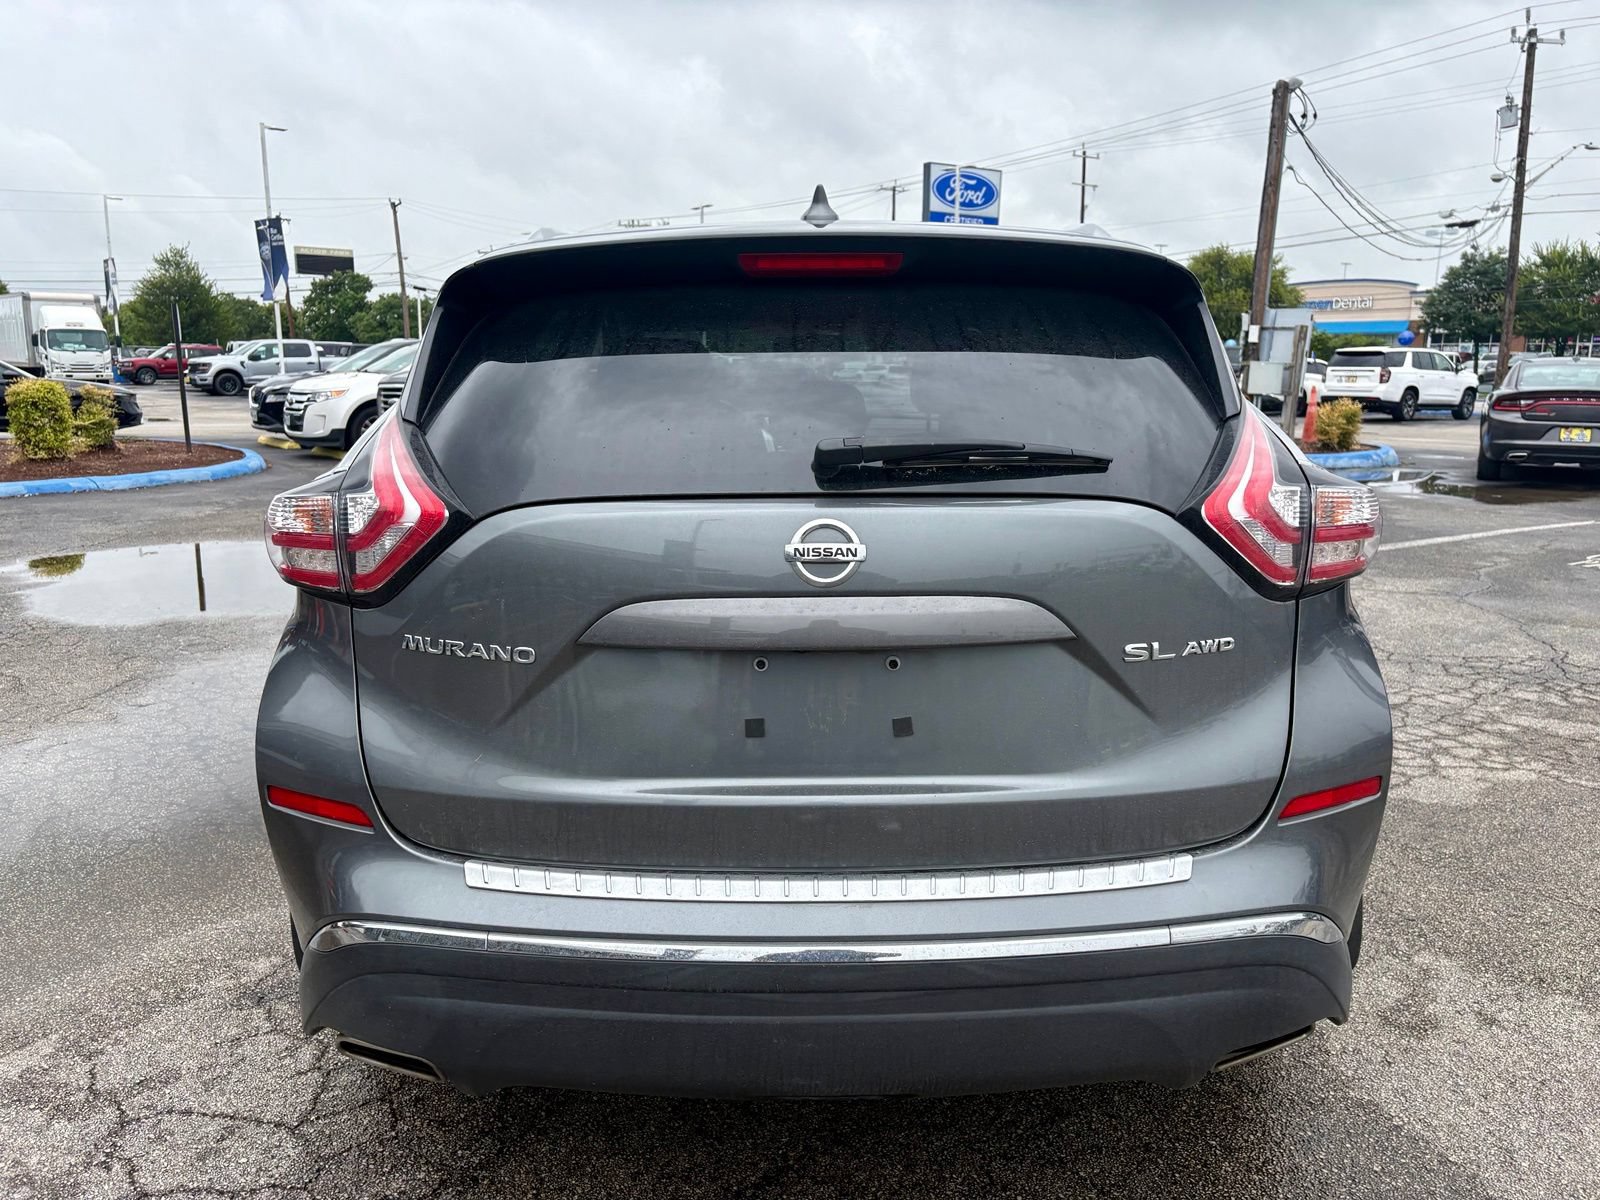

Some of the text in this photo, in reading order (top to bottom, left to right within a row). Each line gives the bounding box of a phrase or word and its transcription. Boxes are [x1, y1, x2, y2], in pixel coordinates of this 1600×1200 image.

[945, 176, 987, 205] Ford
[944, 215, 984, 224] CETIFIED
[1332, 296, 1374, 309] Dental
[793, 547, 858, 558] NISSAN
[401, 634, 536, 664] MURANO
[1123, 637, 1235, 662] SL AWD
